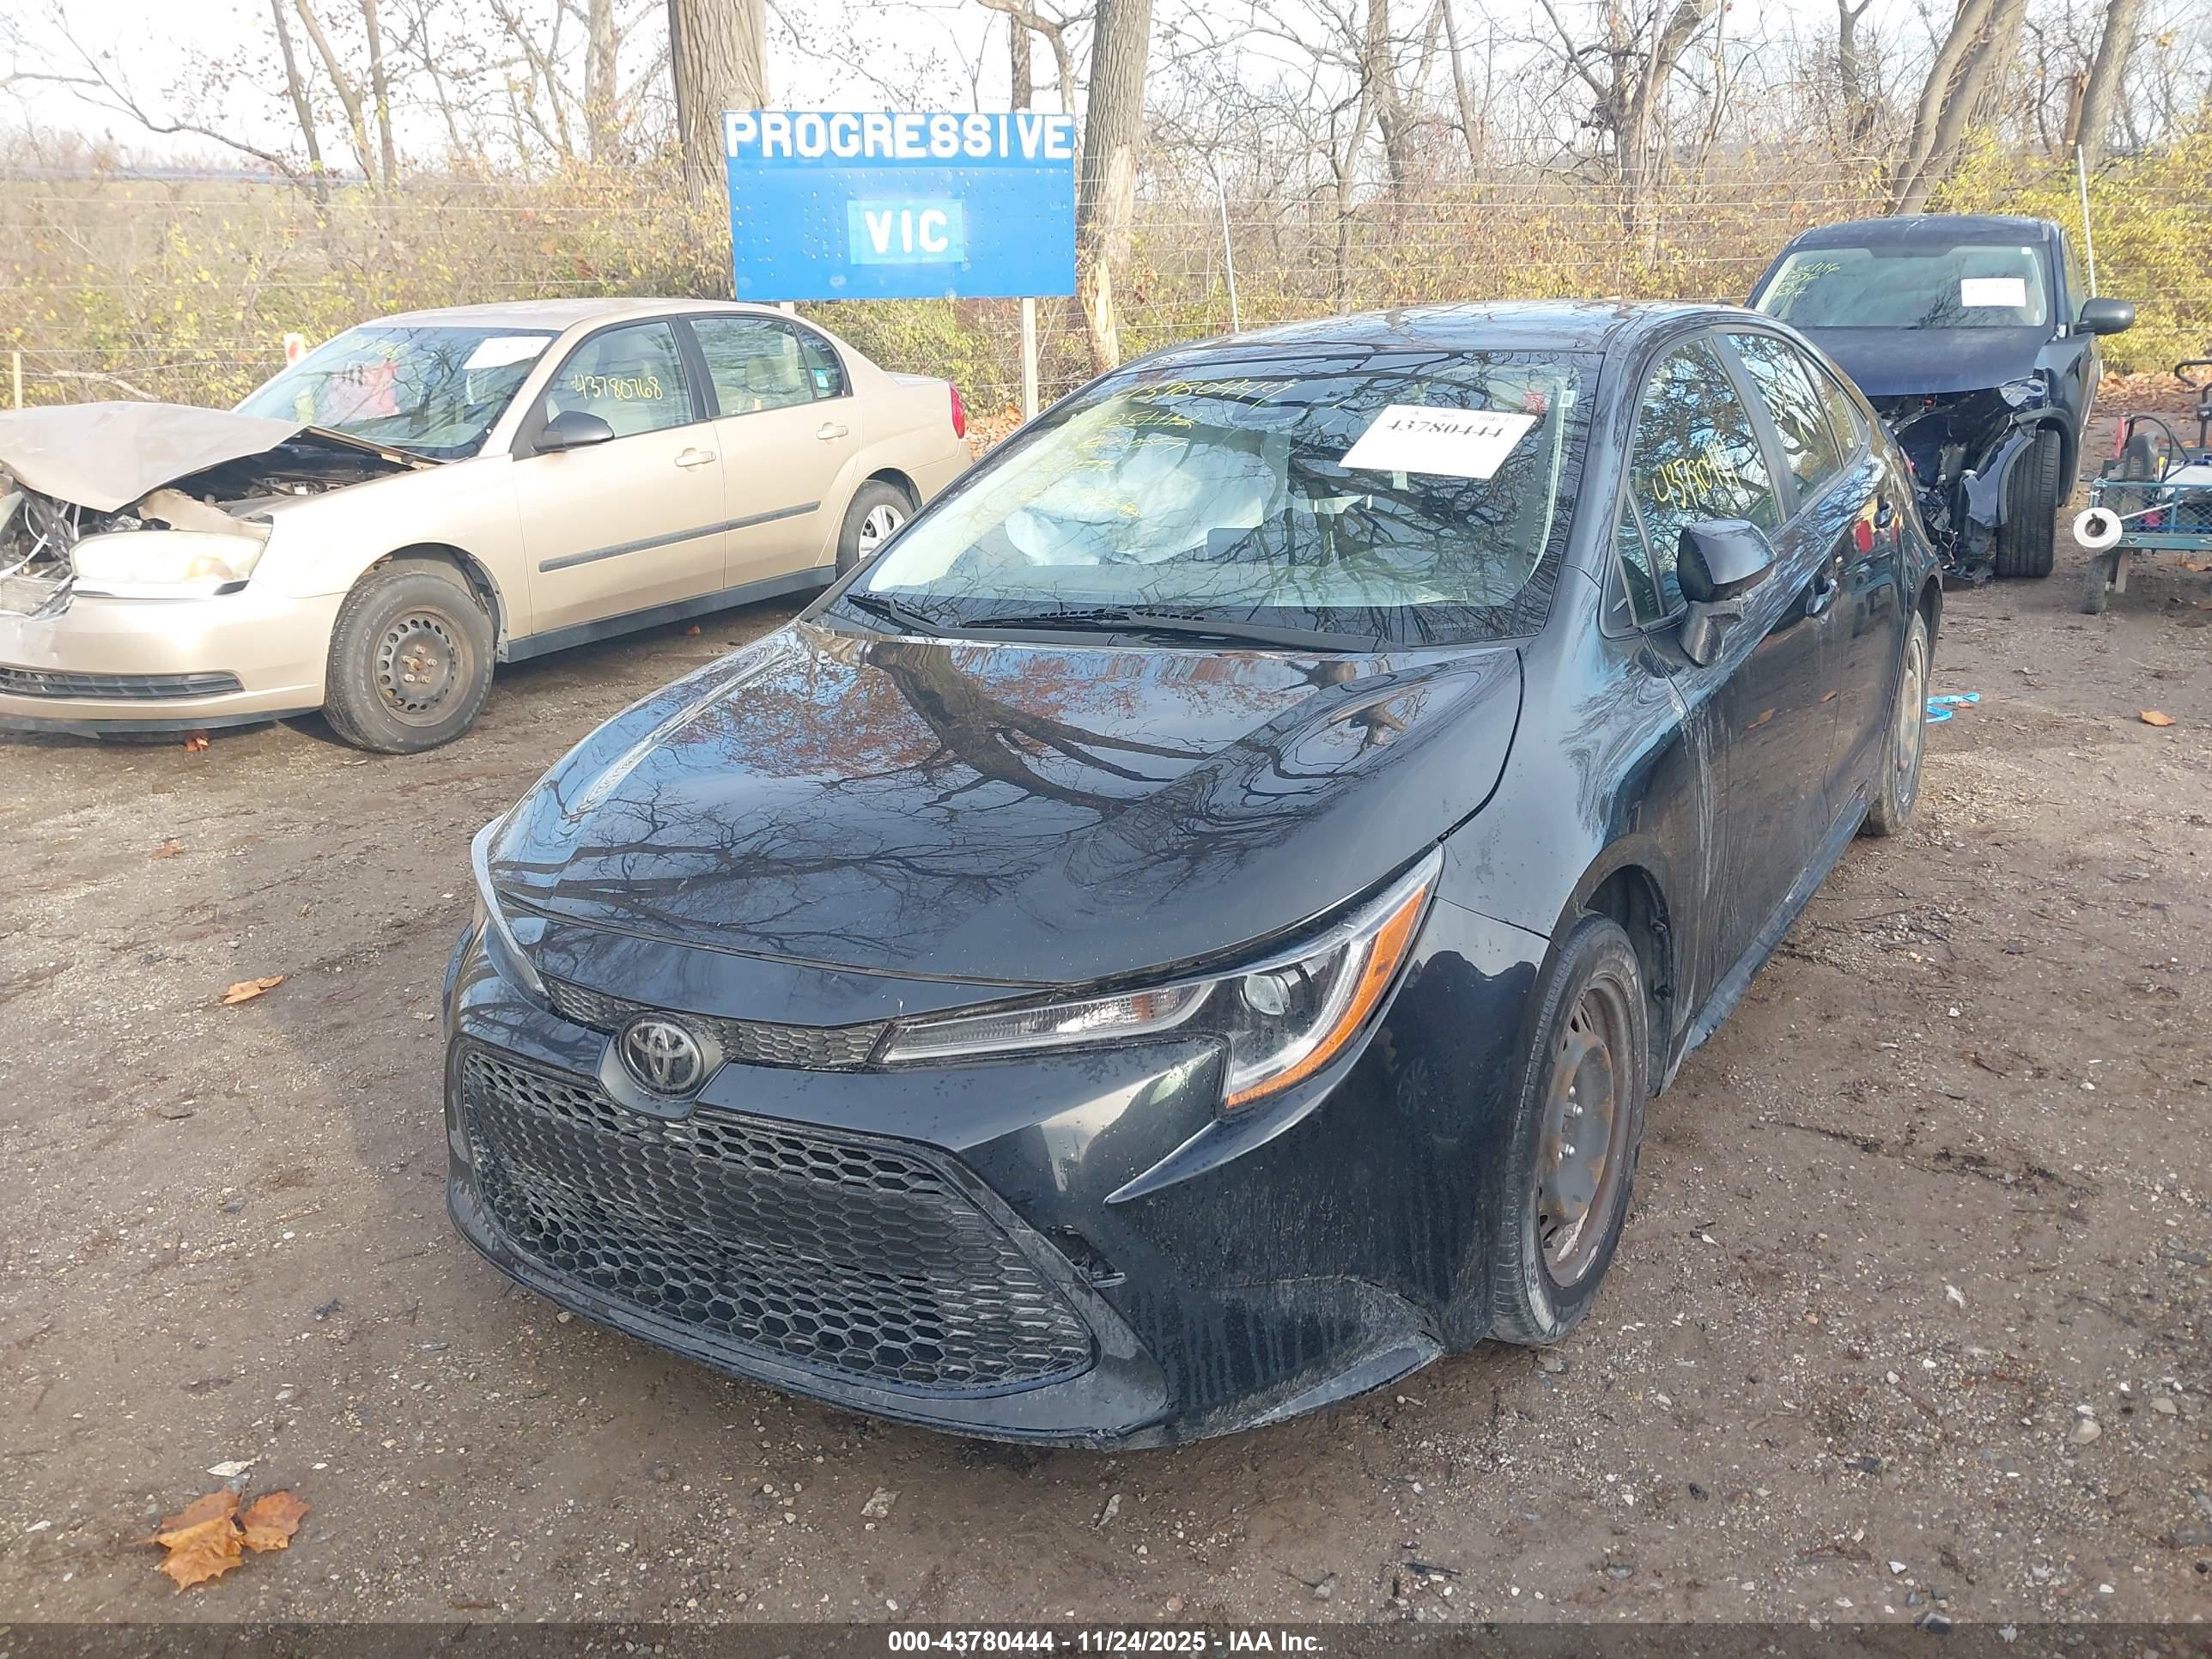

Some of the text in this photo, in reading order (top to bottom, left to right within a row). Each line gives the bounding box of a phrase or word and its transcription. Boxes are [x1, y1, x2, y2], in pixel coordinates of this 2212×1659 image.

[726, 112, 1073, 159] PROGRESSIVE
[865, 209, 949, 253] VIC
[571, 374, 663, 400] 43780768
[1386, 419, 1504, 439] 43780444
